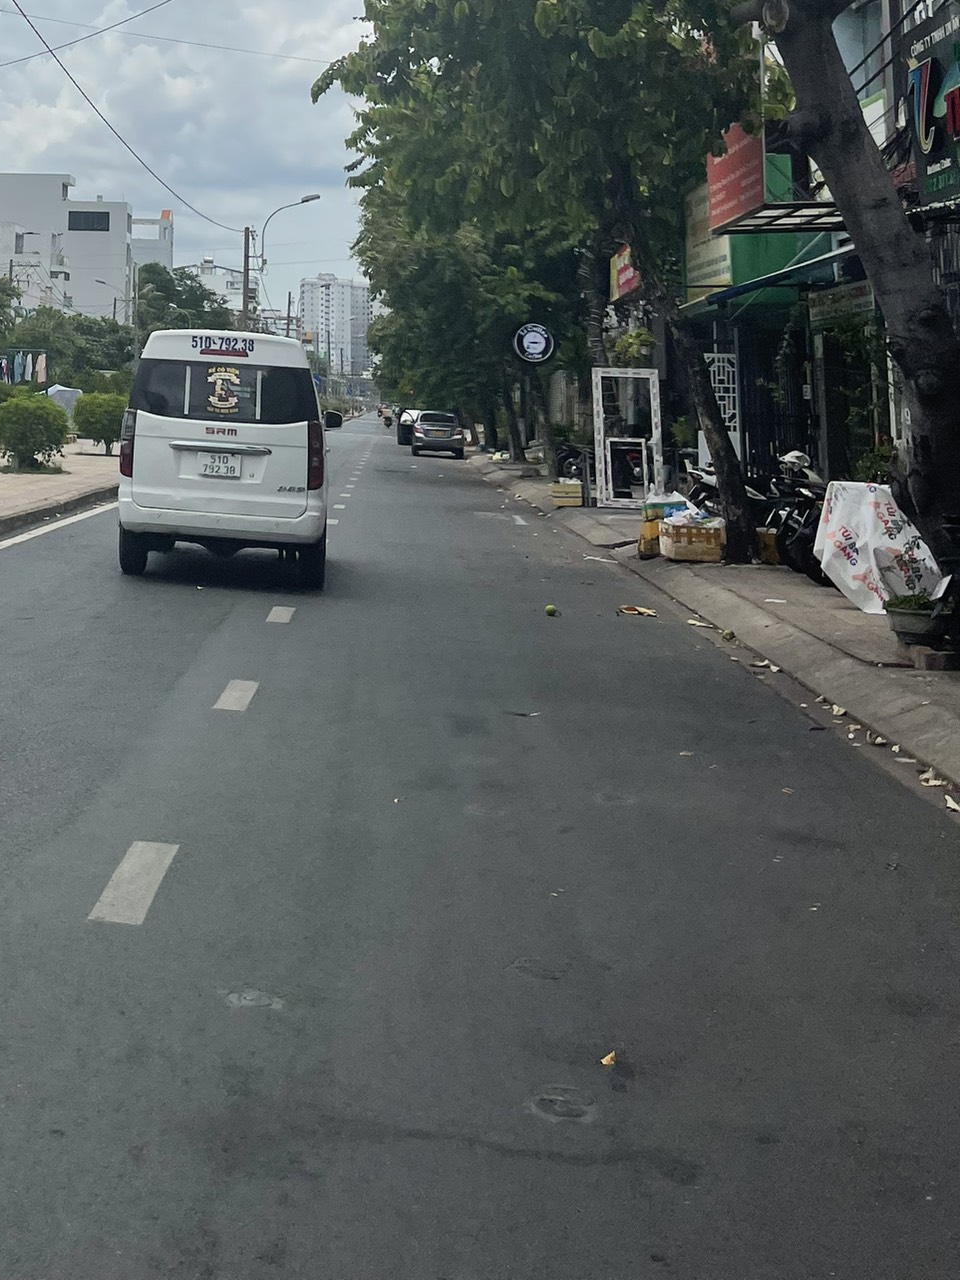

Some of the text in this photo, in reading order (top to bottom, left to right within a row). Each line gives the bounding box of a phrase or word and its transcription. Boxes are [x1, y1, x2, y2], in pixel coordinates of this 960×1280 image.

[205, 426, 238, 436] SRM
[210, 454, 229, 464] 51D
[833, 540, 858, 567] GANG
